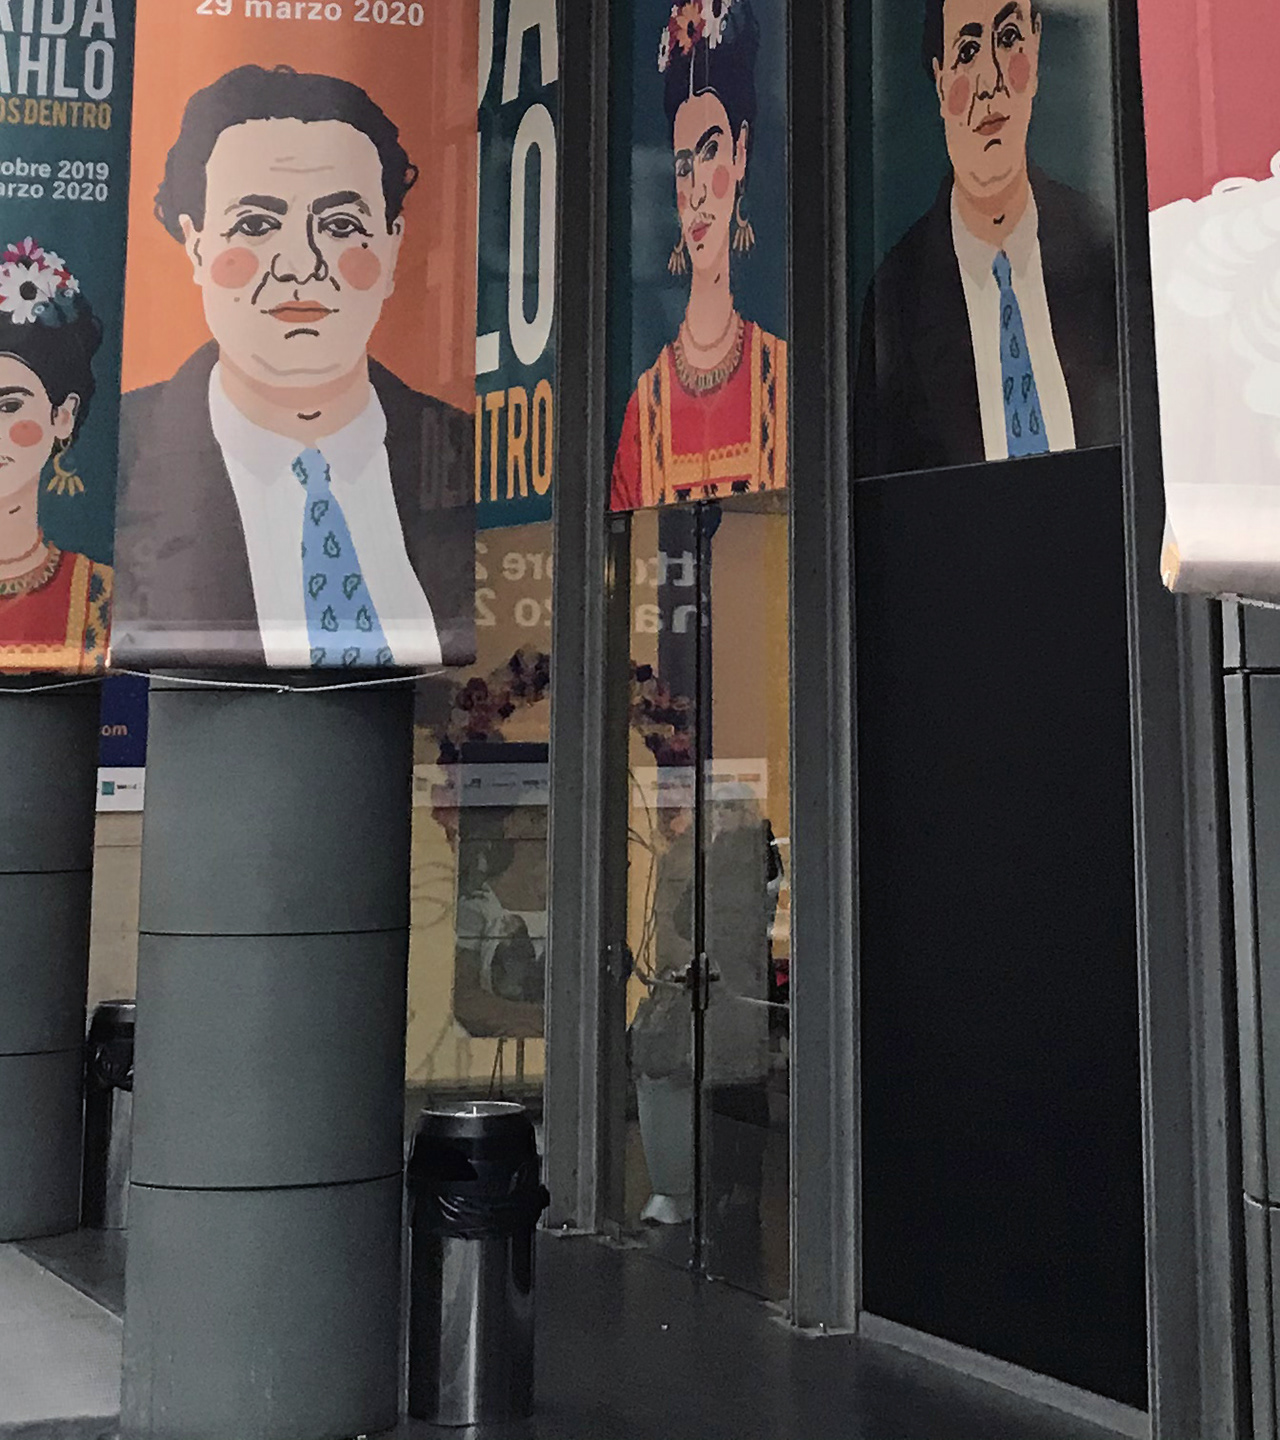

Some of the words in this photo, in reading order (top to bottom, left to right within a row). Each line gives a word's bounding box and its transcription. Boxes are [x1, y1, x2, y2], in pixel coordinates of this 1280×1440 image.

[23, 97, 112, 131] DENTRO
[57, 160, 109, 181] 2019
[52, 181, 109, 202] 2020
